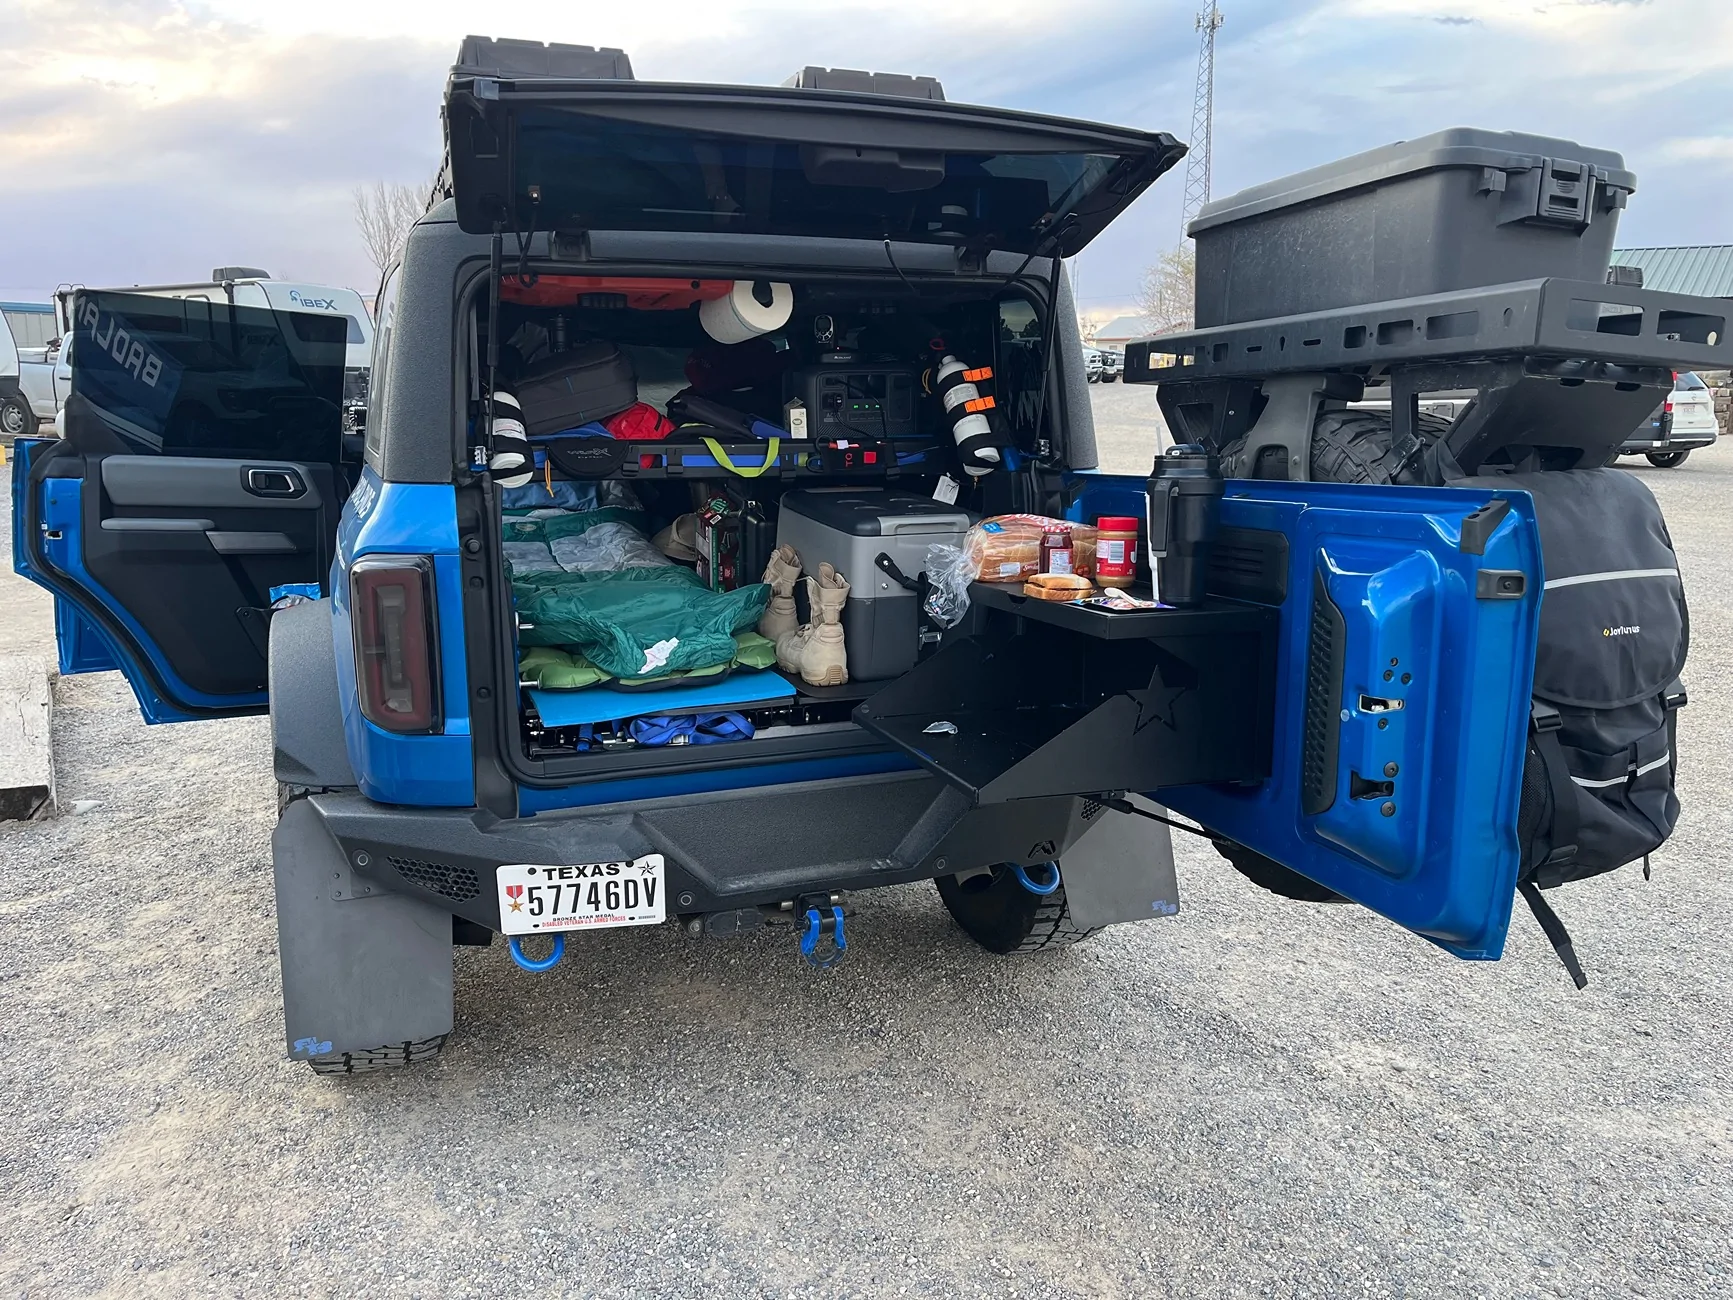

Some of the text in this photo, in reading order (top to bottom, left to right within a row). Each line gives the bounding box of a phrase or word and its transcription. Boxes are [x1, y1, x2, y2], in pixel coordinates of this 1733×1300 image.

[299, 298, 338, 311] IBEX
[542, 863, 620, 881] TEXAS
[527, 877, 657, 917] 57746DV
[542, 920, 563, 928] DISABLED
